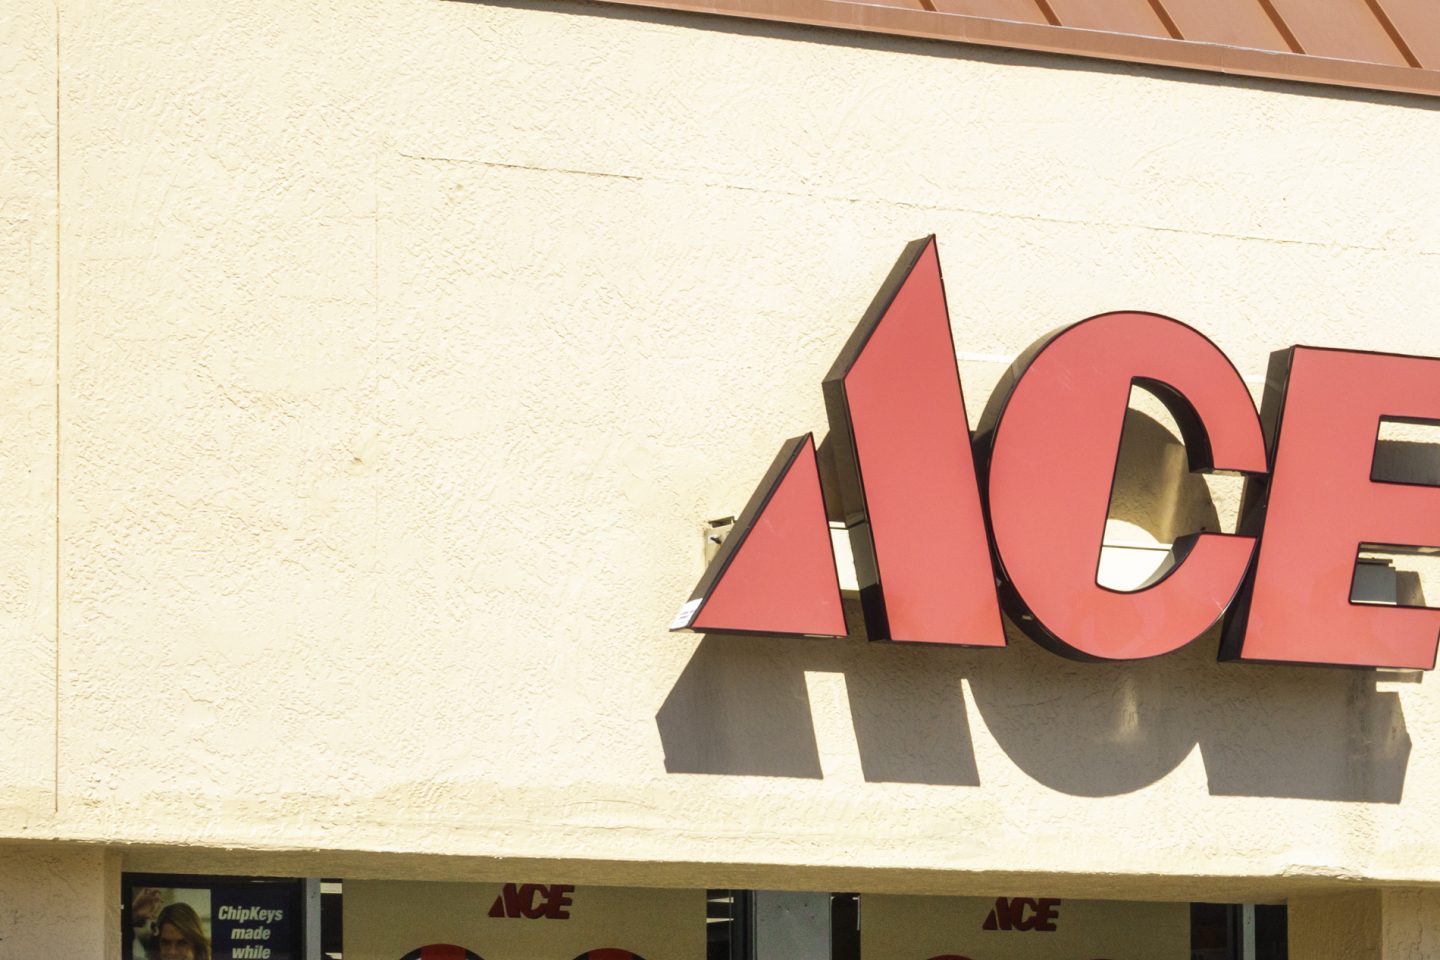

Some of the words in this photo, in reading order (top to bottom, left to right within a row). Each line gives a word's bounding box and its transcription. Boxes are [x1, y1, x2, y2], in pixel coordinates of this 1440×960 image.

[488, 882, 575, 919] ACE
[218, 905, 284, 924] ChipKeys
[982, 896, 1061, 932] ACE
[231, 926, 271, 940] made
[232, 945, 272, 959] while
